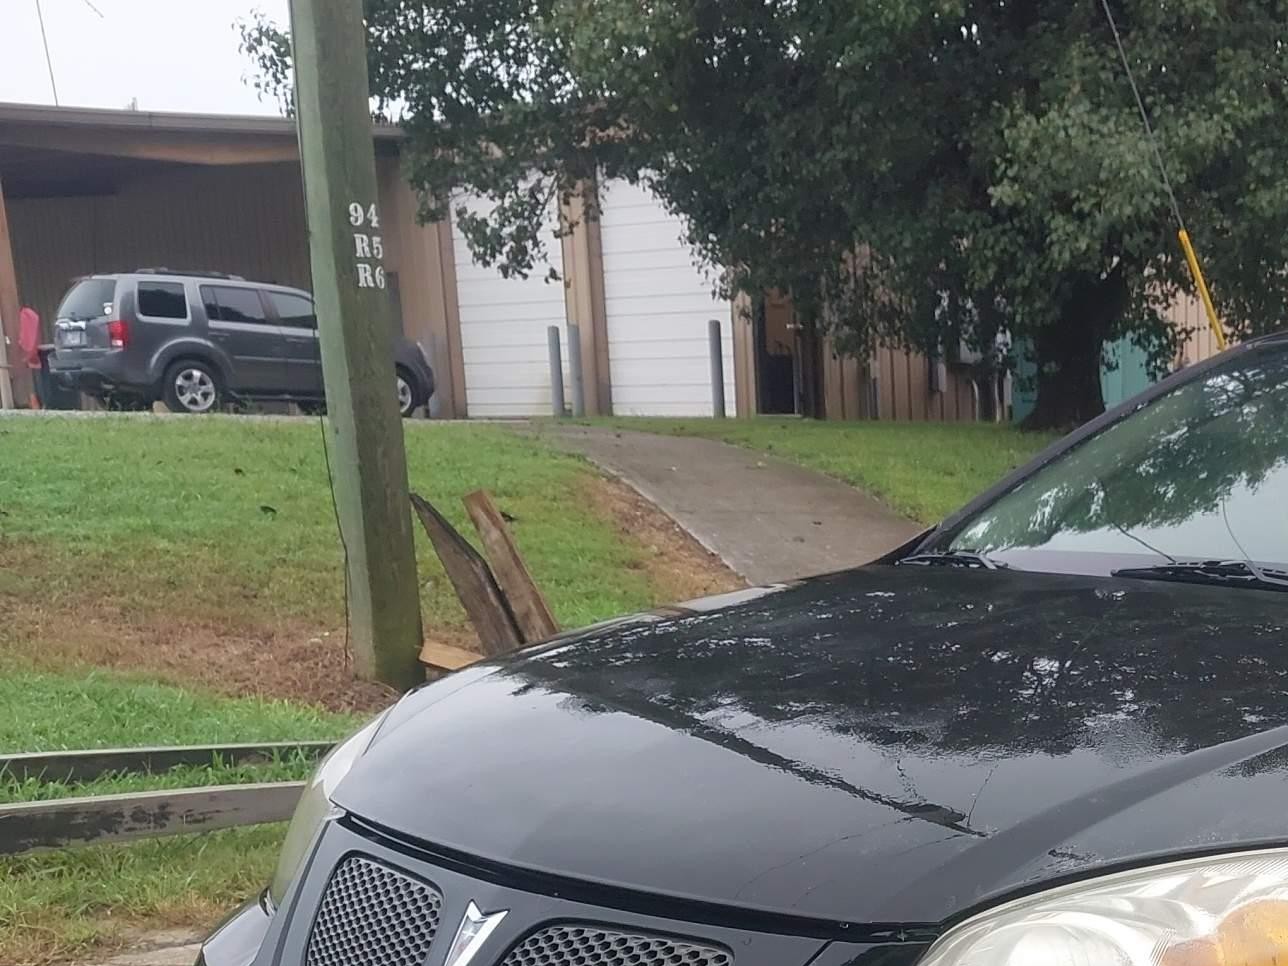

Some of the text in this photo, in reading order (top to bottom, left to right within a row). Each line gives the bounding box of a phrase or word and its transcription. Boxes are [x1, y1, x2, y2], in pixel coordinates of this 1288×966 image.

[348, 202, 380, 228] 94
[353, 233, 384, 260] R5
[356, 262, 386, 290] R6
